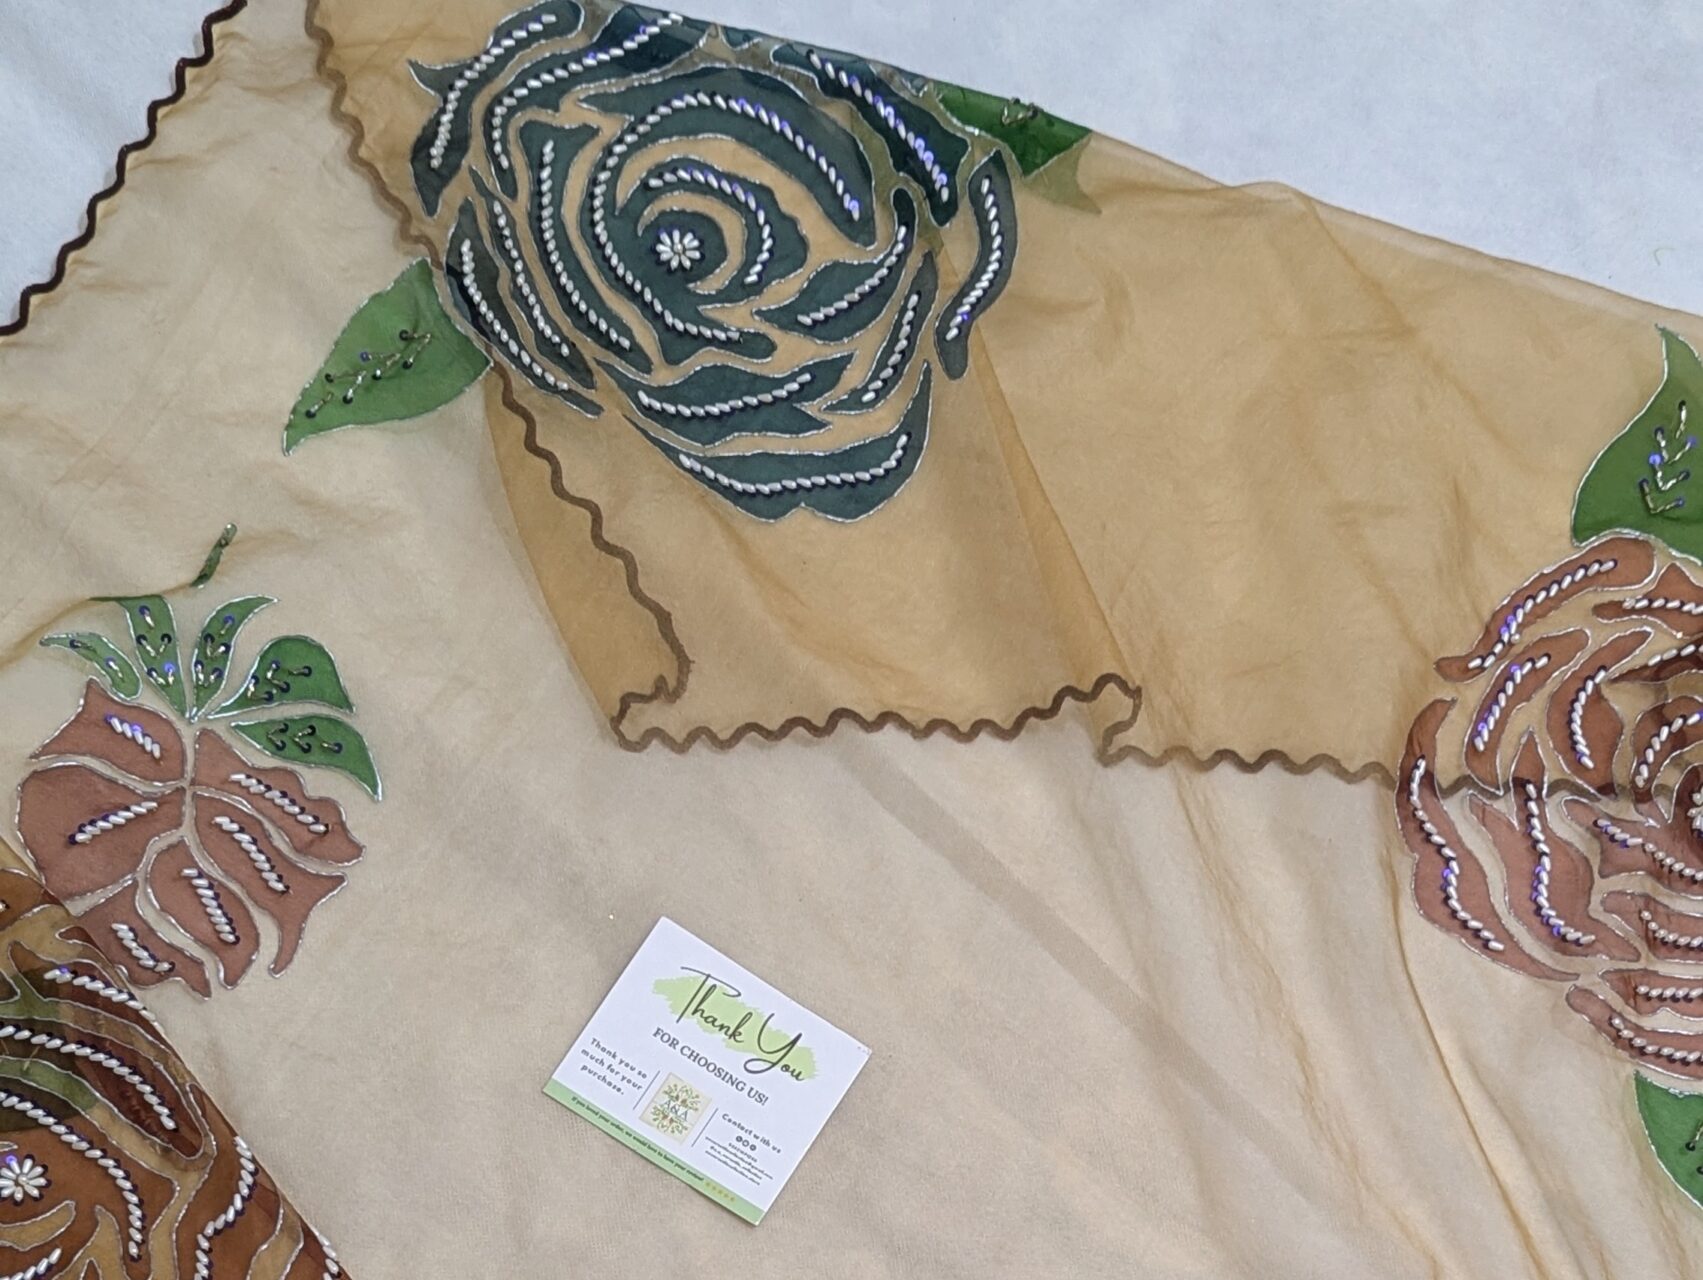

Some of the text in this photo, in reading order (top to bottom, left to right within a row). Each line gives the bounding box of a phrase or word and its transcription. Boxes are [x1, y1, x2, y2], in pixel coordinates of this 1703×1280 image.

[675, 966, 804, 1082] Thank You
[580, 1048, 643, 1091] much for your
[590, 1037, 648, 1079] Thank you so
[652, 1026, 769, 1106] FOR CHOOSING US!
[580, 1064, 624, 1096] purchase.
[662, 1099, 688, 1122] A&A
[721, 1113, 753, 1136] Contact
[752, 1133, 771, 1147] with
[771, 1145, 782, 1154] us
